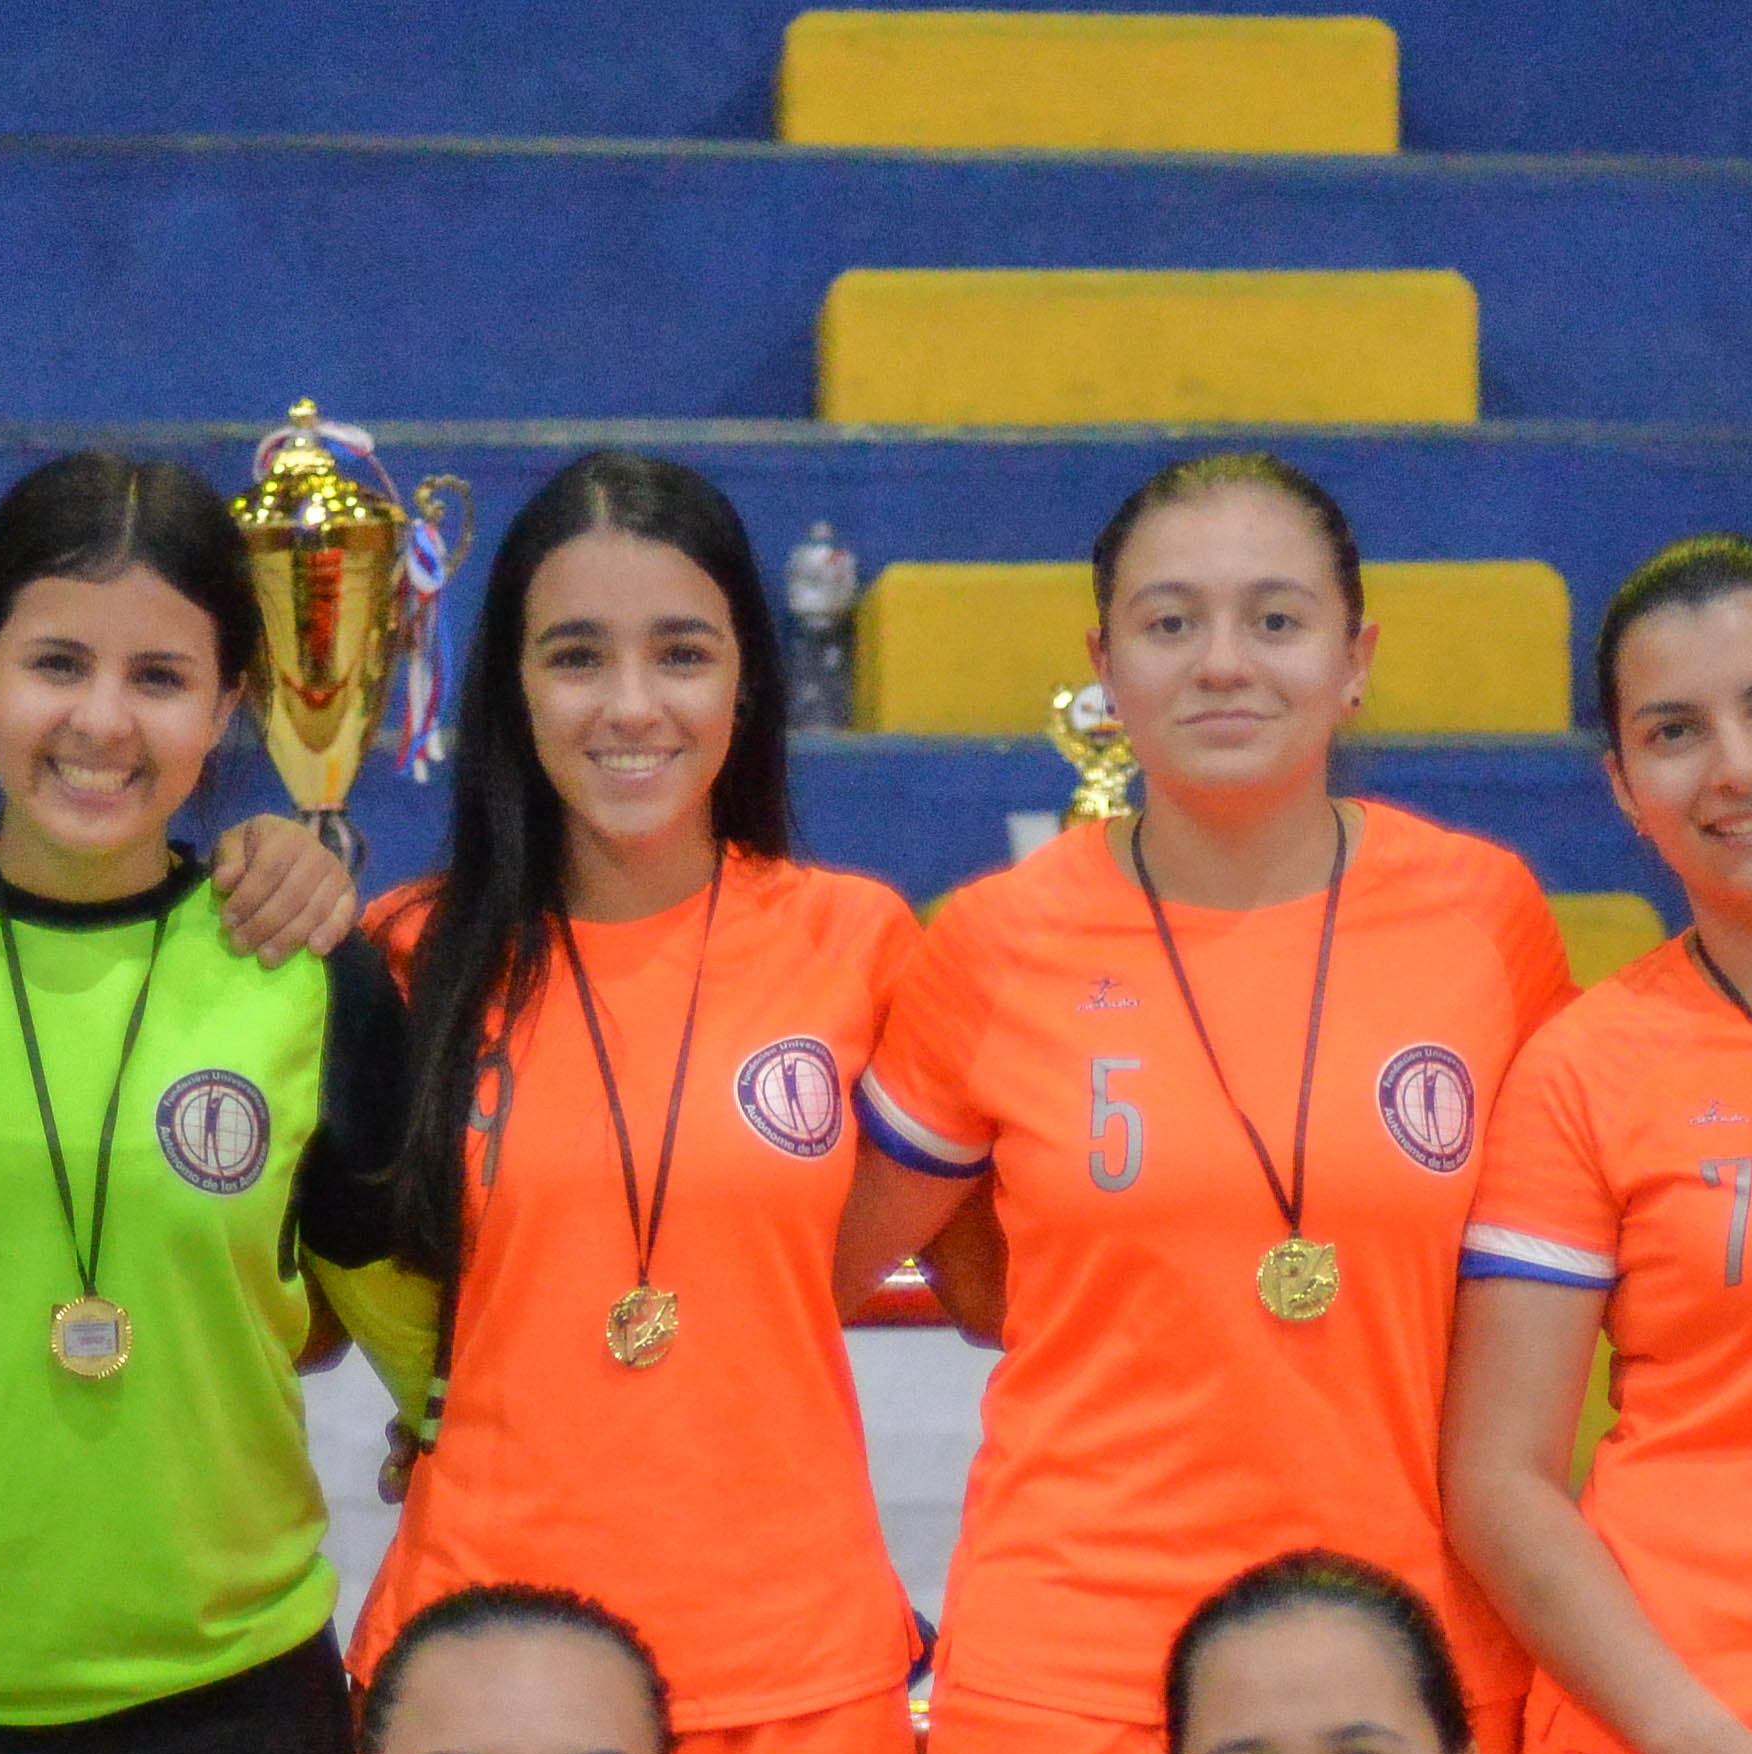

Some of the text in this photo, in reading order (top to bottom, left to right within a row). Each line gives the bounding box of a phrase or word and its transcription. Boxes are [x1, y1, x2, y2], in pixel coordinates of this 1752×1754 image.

[202, 1178, 219, 1190] de
[221, 1180, 239, 1192] las
[468, 1052, 515, 1186] 9
[1089, 1057, 1144, 1193] 5
